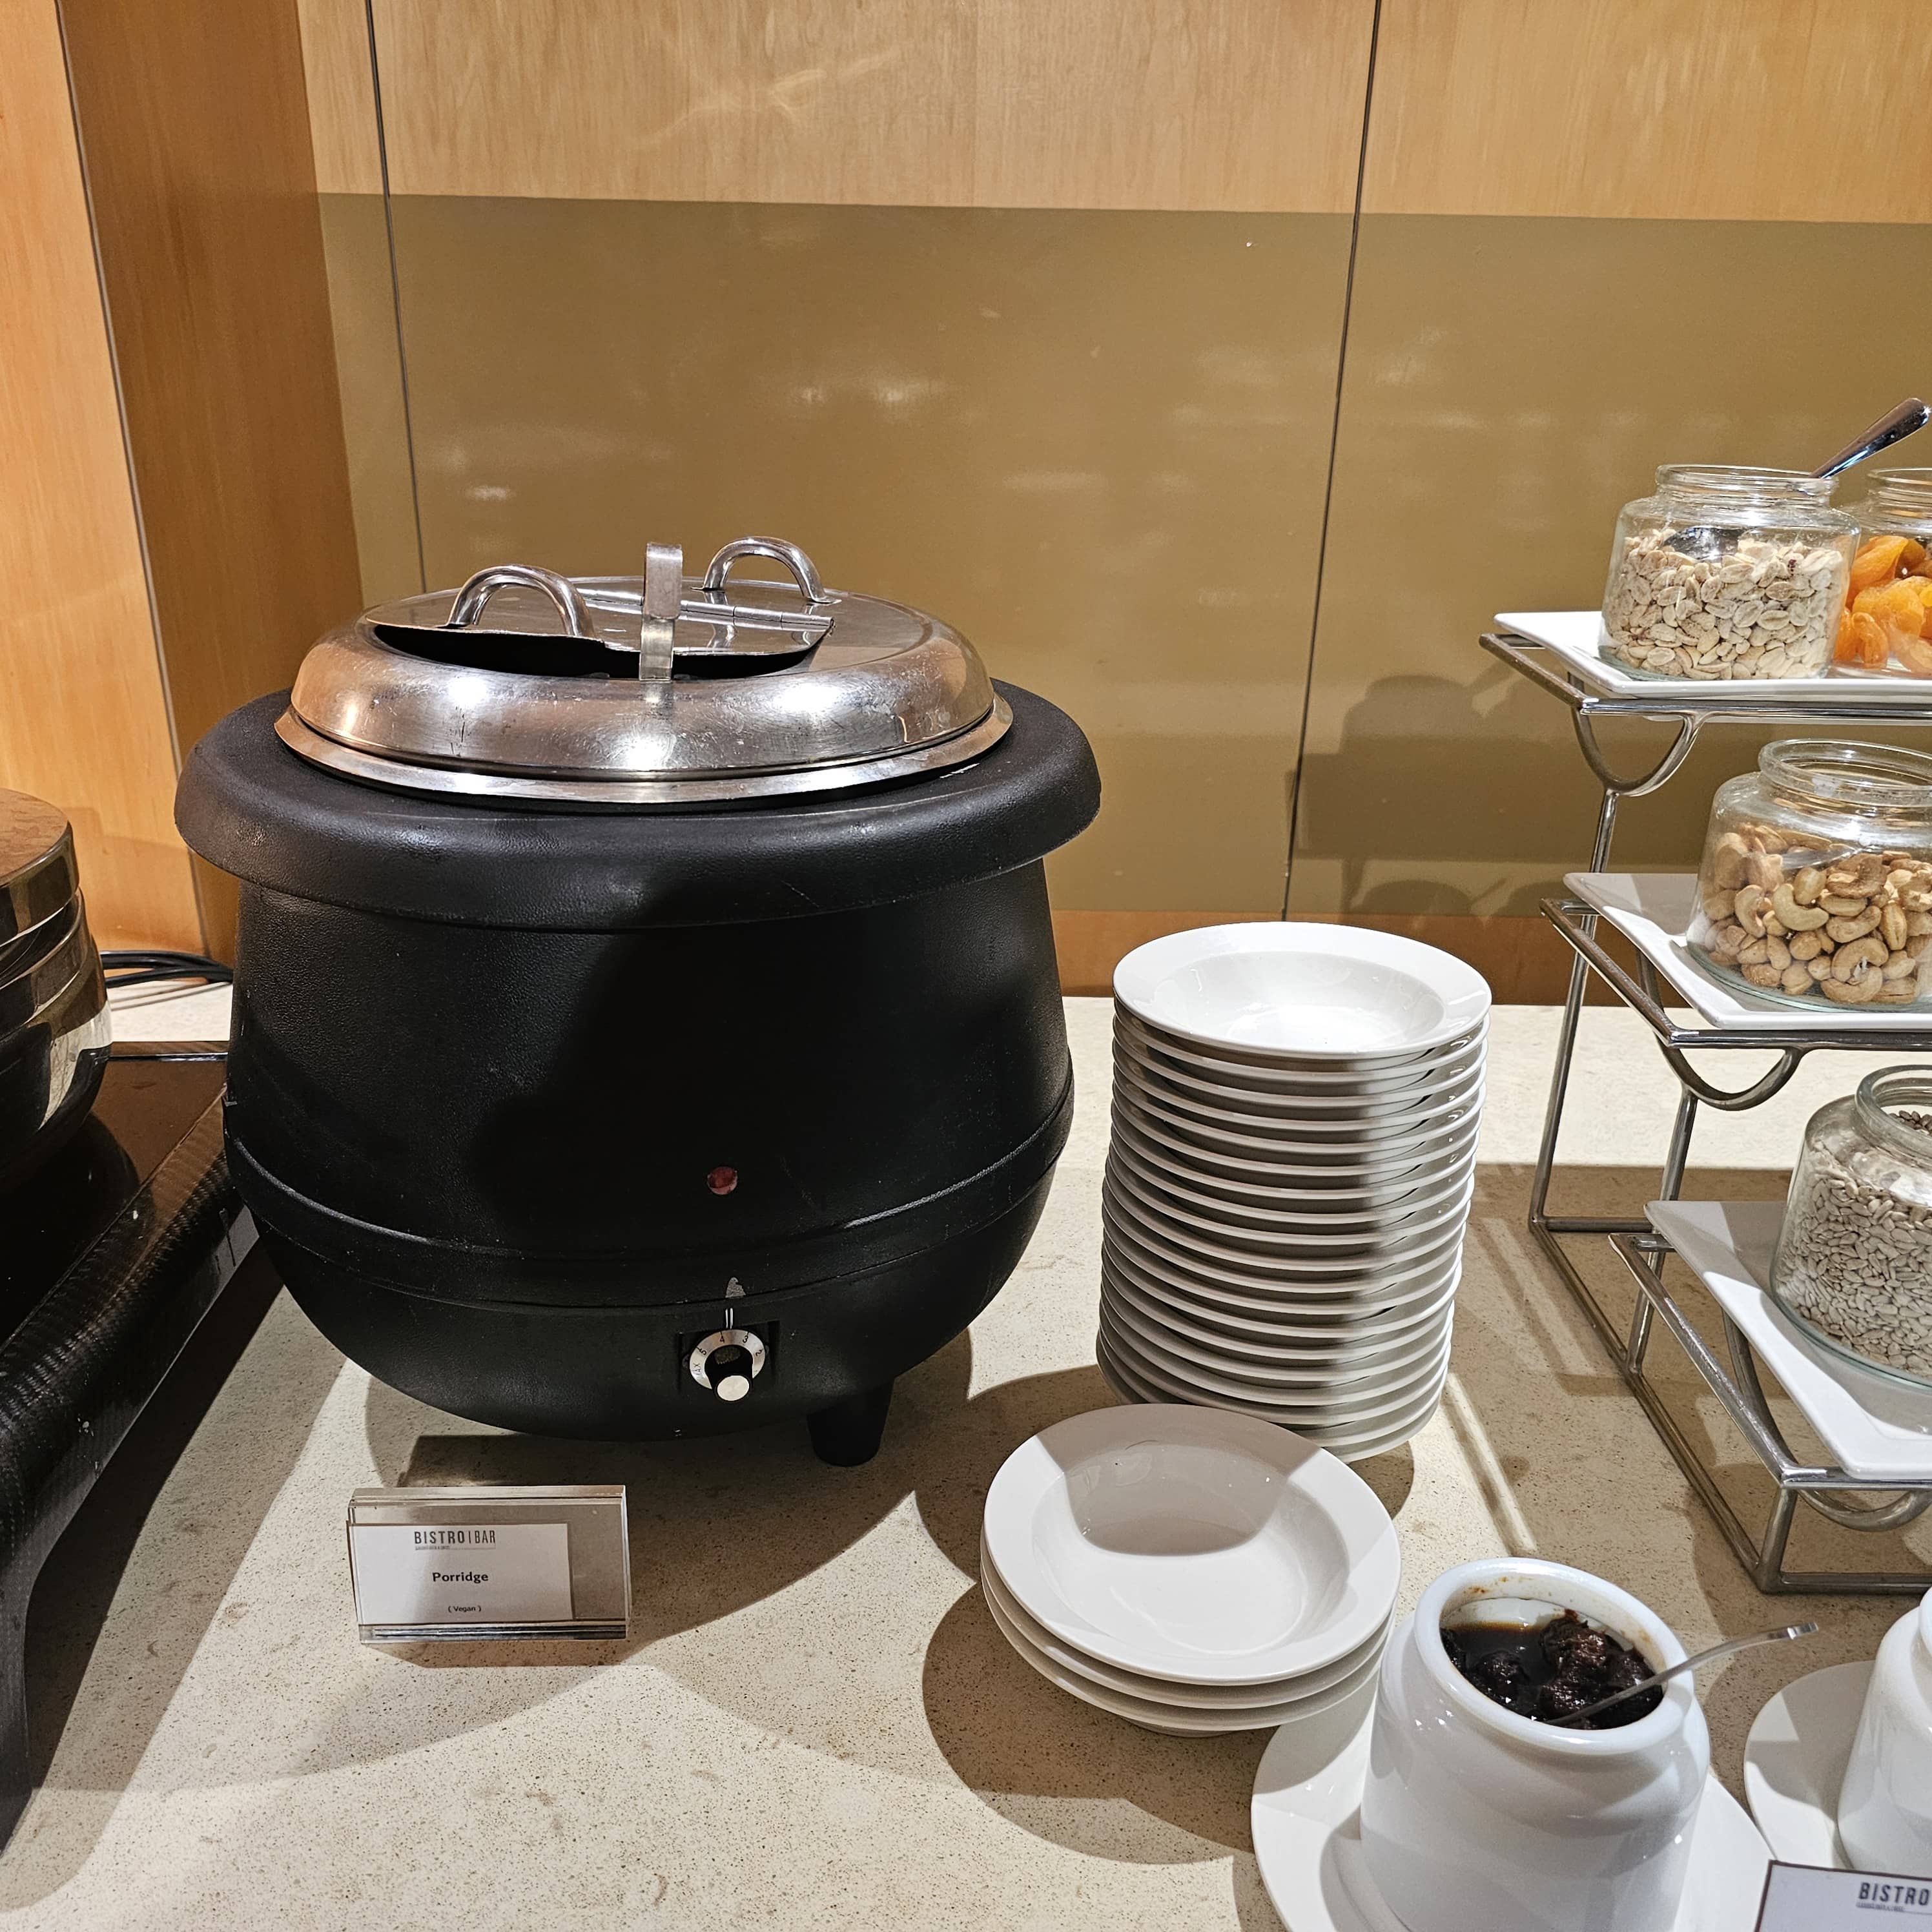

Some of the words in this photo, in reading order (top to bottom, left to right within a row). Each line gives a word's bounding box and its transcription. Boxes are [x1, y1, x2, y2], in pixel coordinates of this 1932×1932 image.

[719, 1335, 725, 1344] 4
[742, 1335, 749, 1344] 3
[432, 1571, 489, 1583] Porridge
[1858, 1882, 1931, 1906] BISTRO
